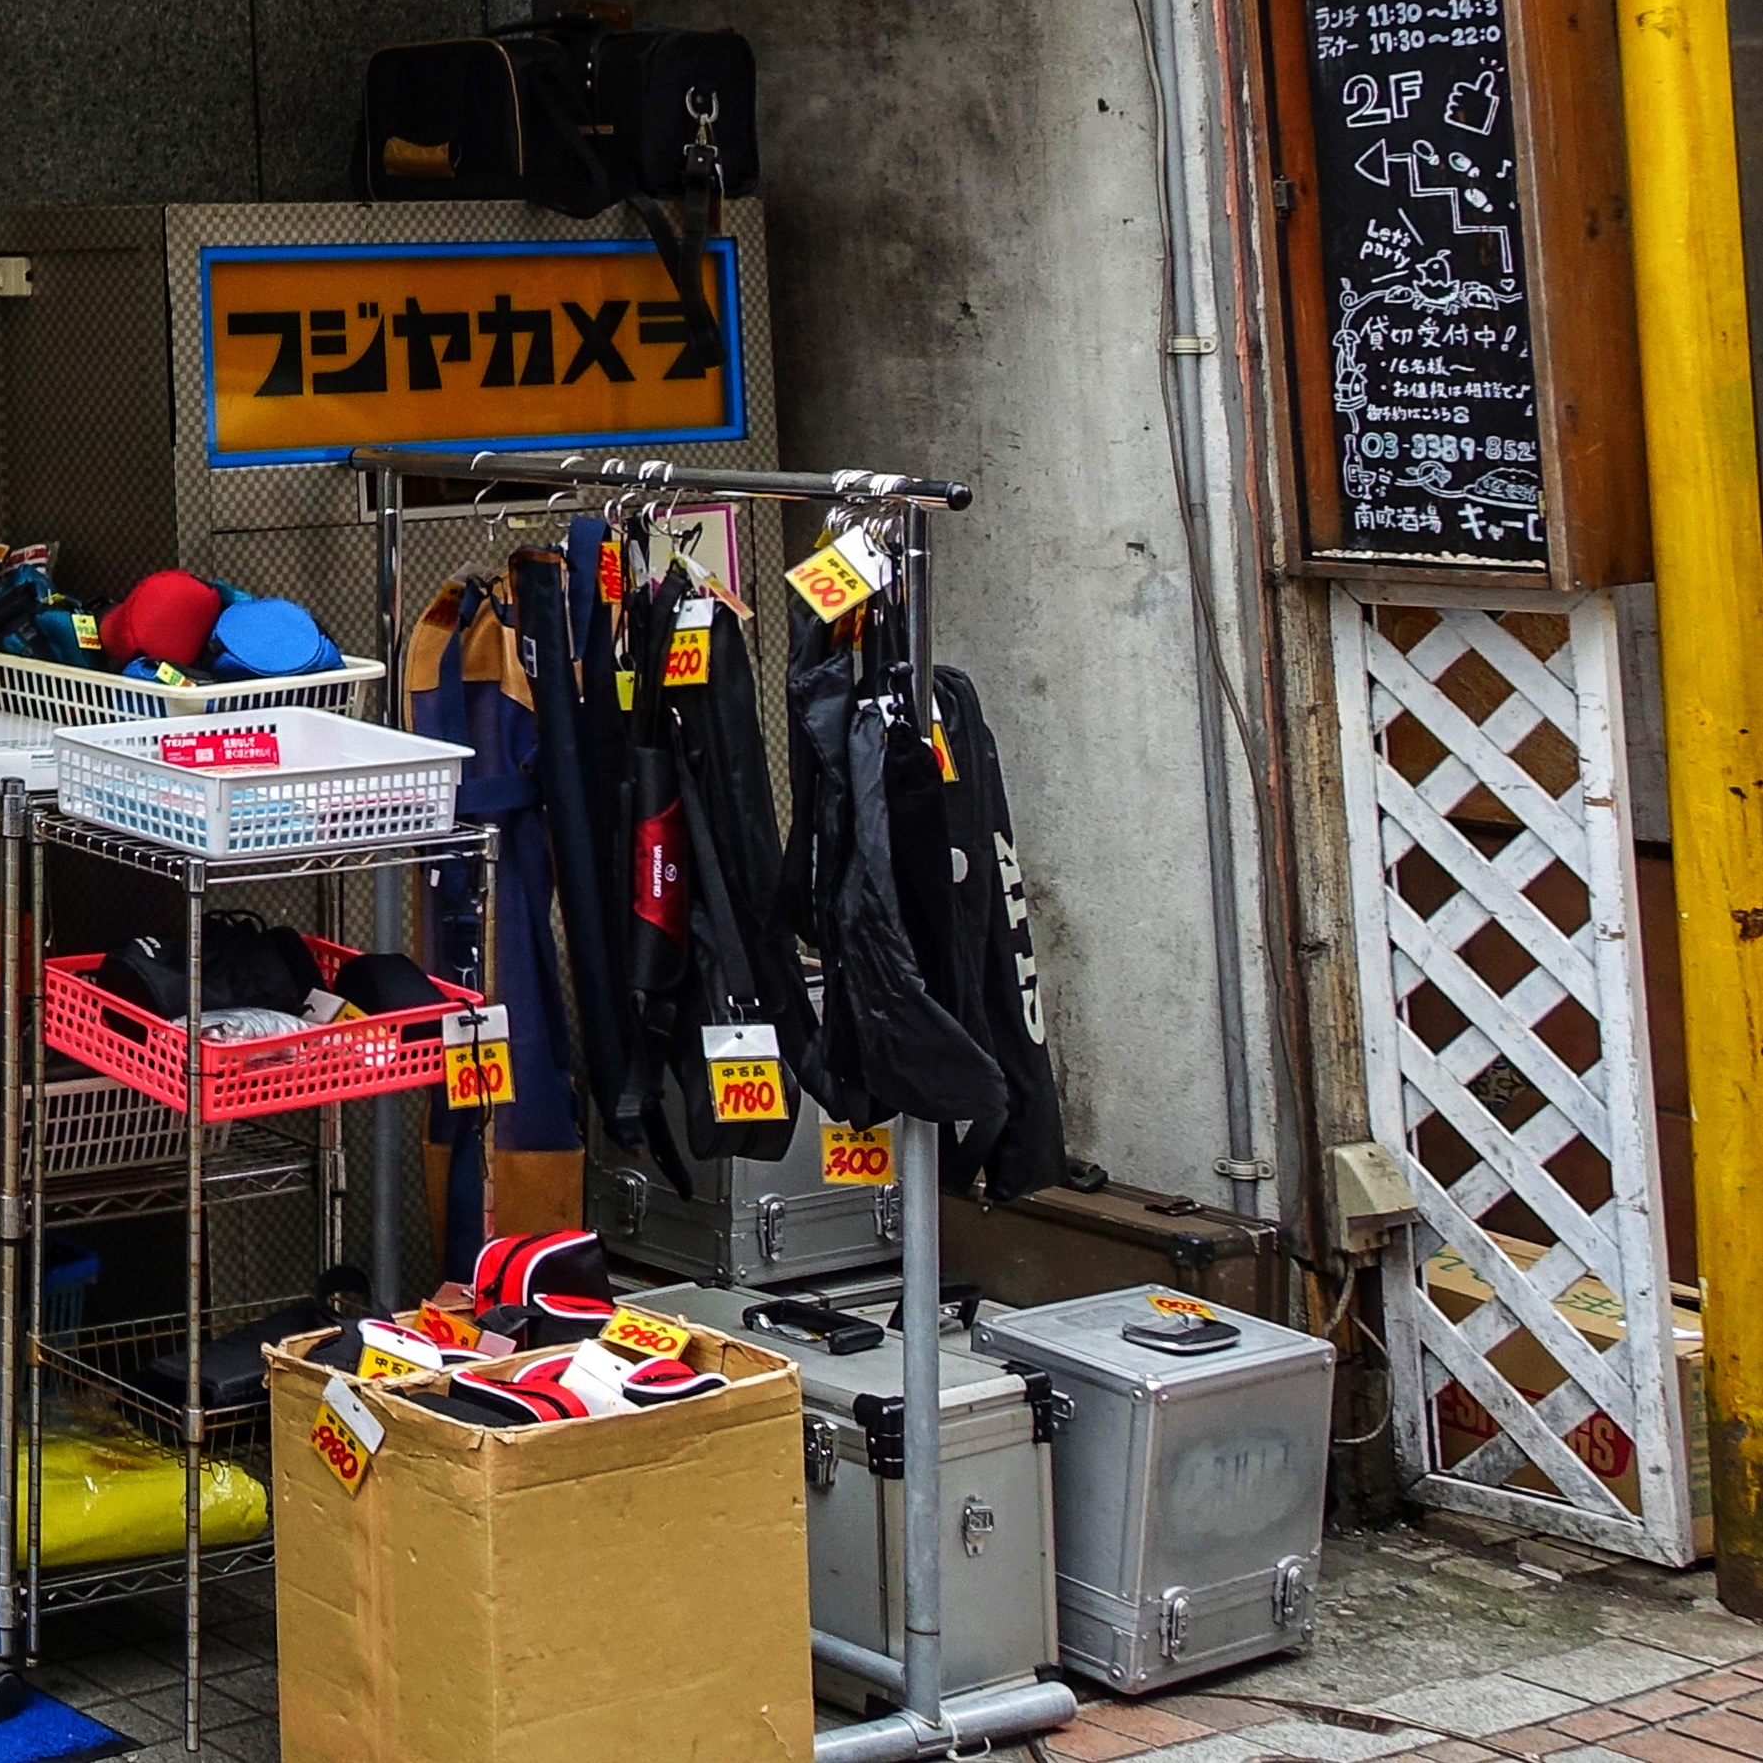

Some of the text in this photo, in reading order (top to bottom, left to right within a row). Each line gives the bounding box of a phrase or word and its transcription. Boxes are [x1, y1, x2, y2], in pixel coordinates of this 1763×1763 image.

[1343, 70, 1423, 128] 2F
[227, 293, 714, 398] フジヤカメラ
[1360, 432, 1536, 462] 03-3389-852
